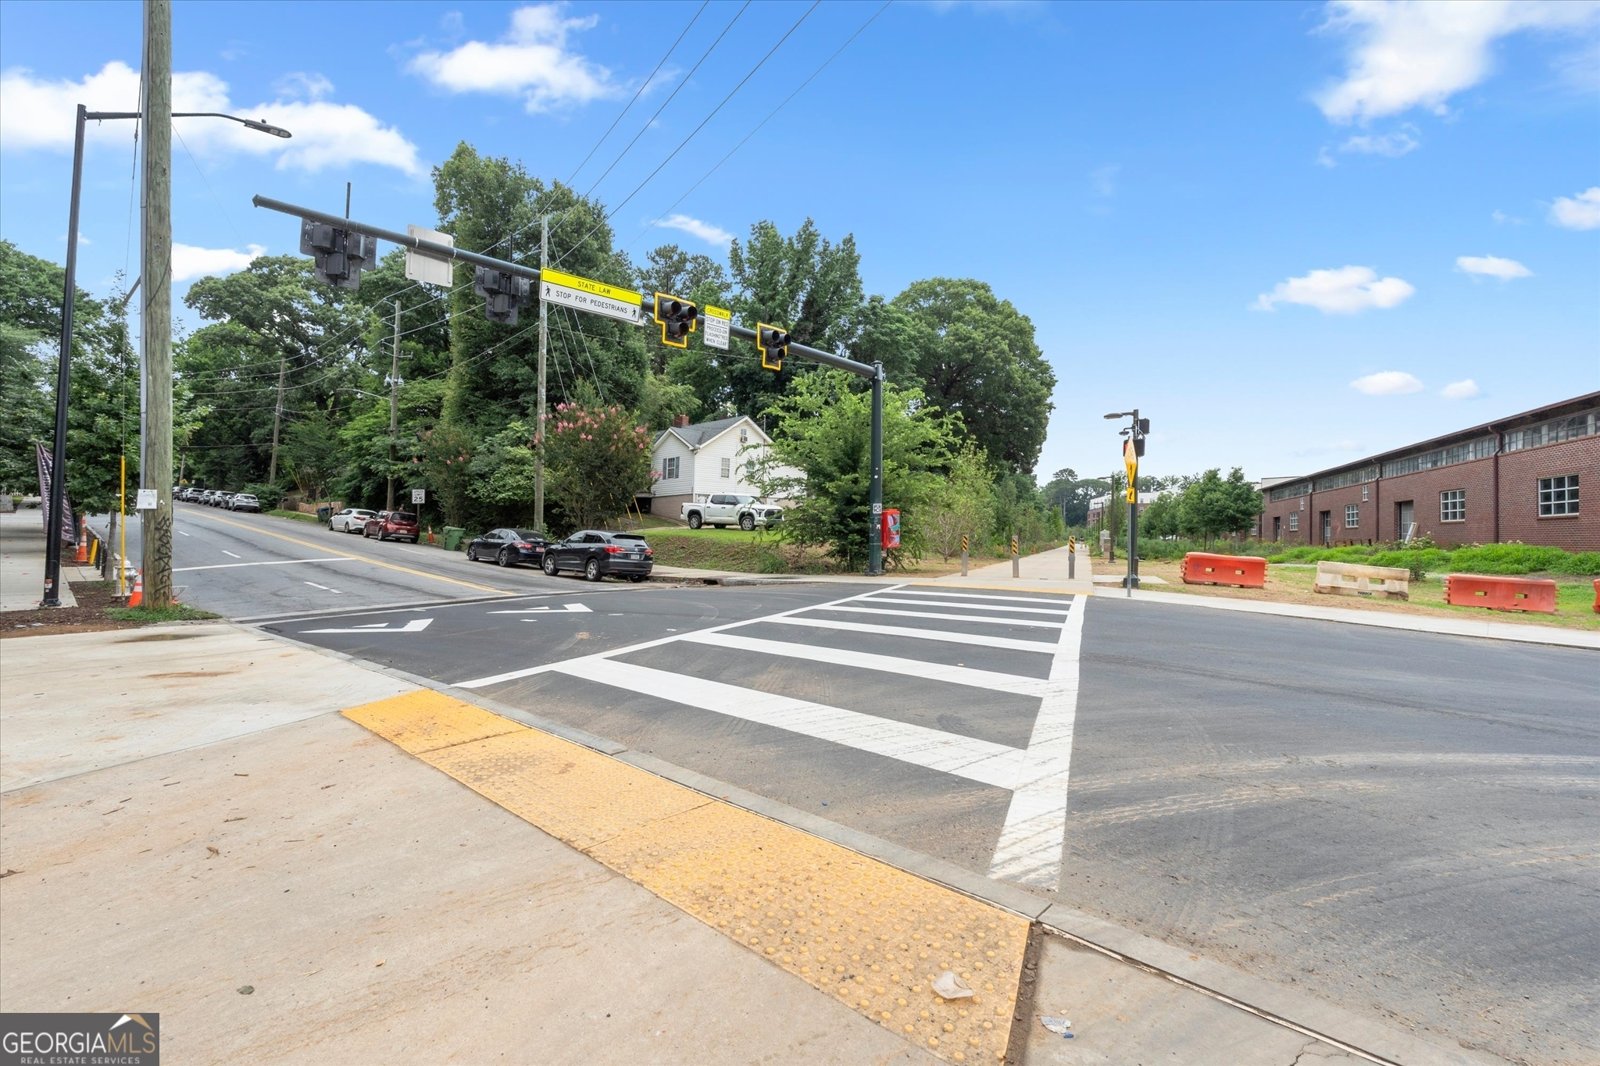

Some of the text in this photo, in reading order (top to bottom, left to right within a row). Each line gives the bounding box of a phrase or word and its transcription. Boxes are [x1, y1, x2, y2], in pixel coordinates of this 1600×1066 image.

[578, 281, 596, 291] STATE
[556, 290, 628, 314] STOP FOR PEDESTRIANS
